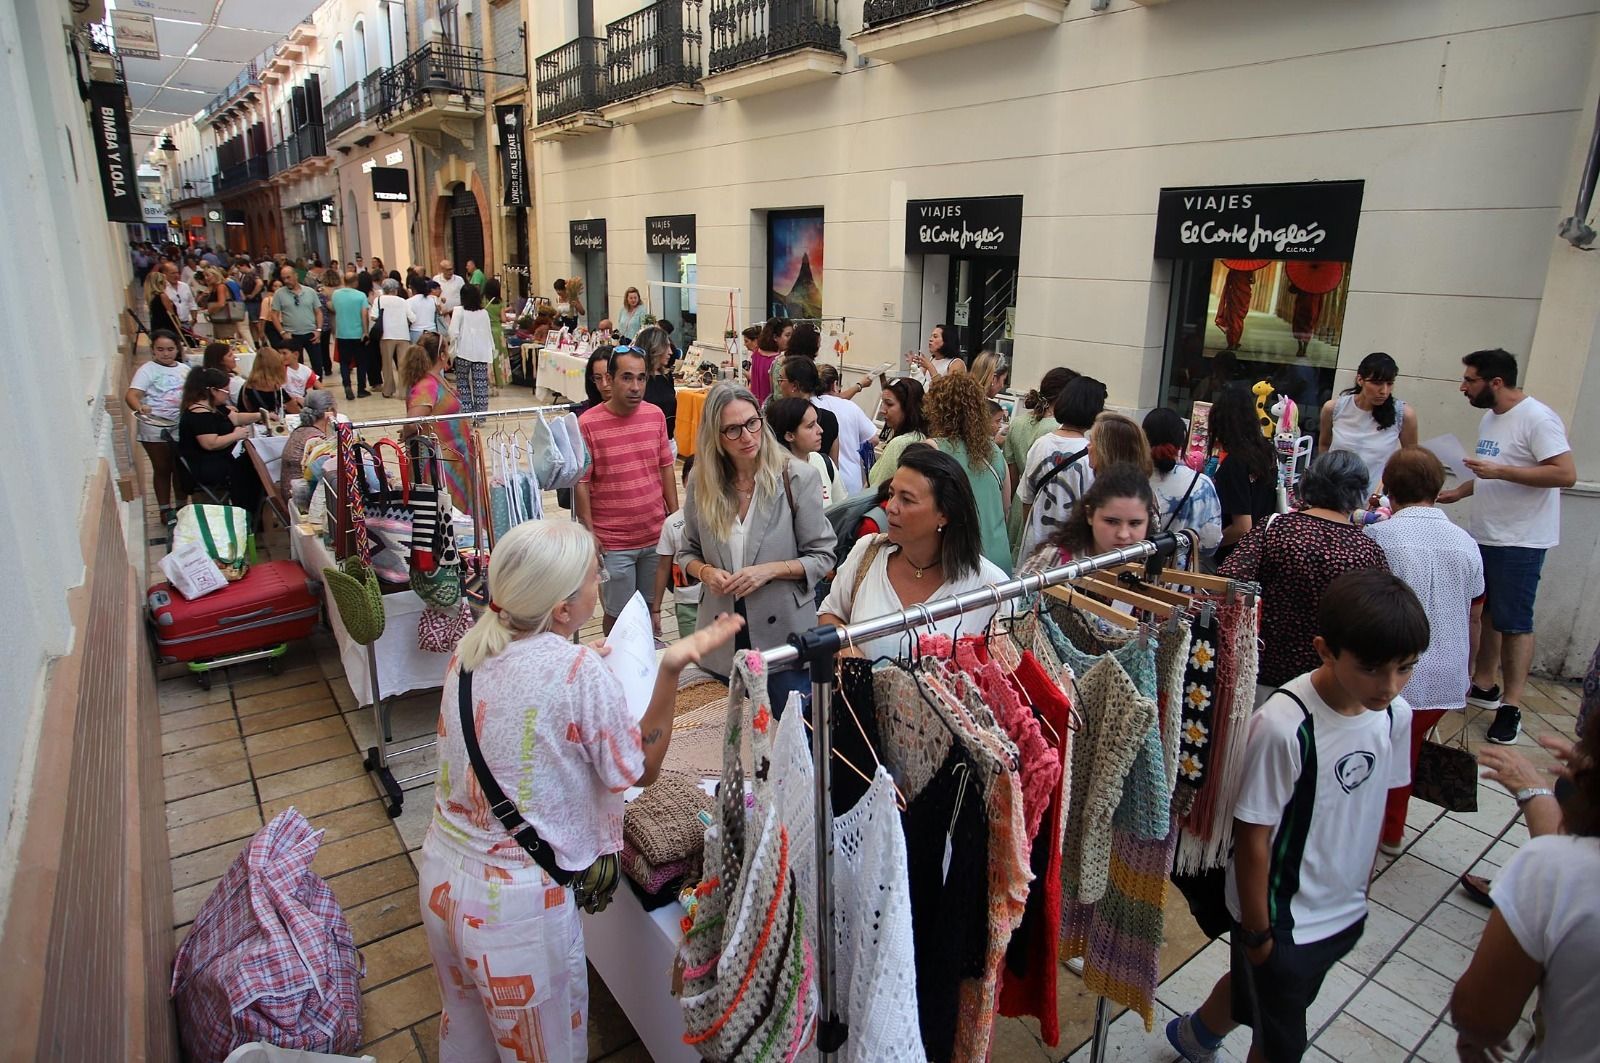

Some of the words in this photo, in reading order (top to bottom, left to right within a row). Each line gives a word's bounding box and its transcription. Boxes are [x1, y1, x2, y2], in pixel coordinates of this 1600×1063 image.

[101, 106, 118, 149] BIMBA
[107, 153, 121, 162] Y
[507, 133, 518, 160] ESTATE
[110, 165, 126, 197] LOLA
[510, 161, 519, 180] REAL
[511, 181, 520, 204] LYNCIS
[1184, 194, 1252, 213] VIAJES
[920, 205, 961, 219] VIAJES
[652, 220, 671, 230] VIAJES
[919, 225, 931, 243] El
[932, 225, 960, 243] Corte
[960, 219, 1005, 249] Inglés
[1180, 220, 1199, 244] El
[1200, 220, 1248, 244] Corte
[1249, 214, 1326, 252] Inglés
